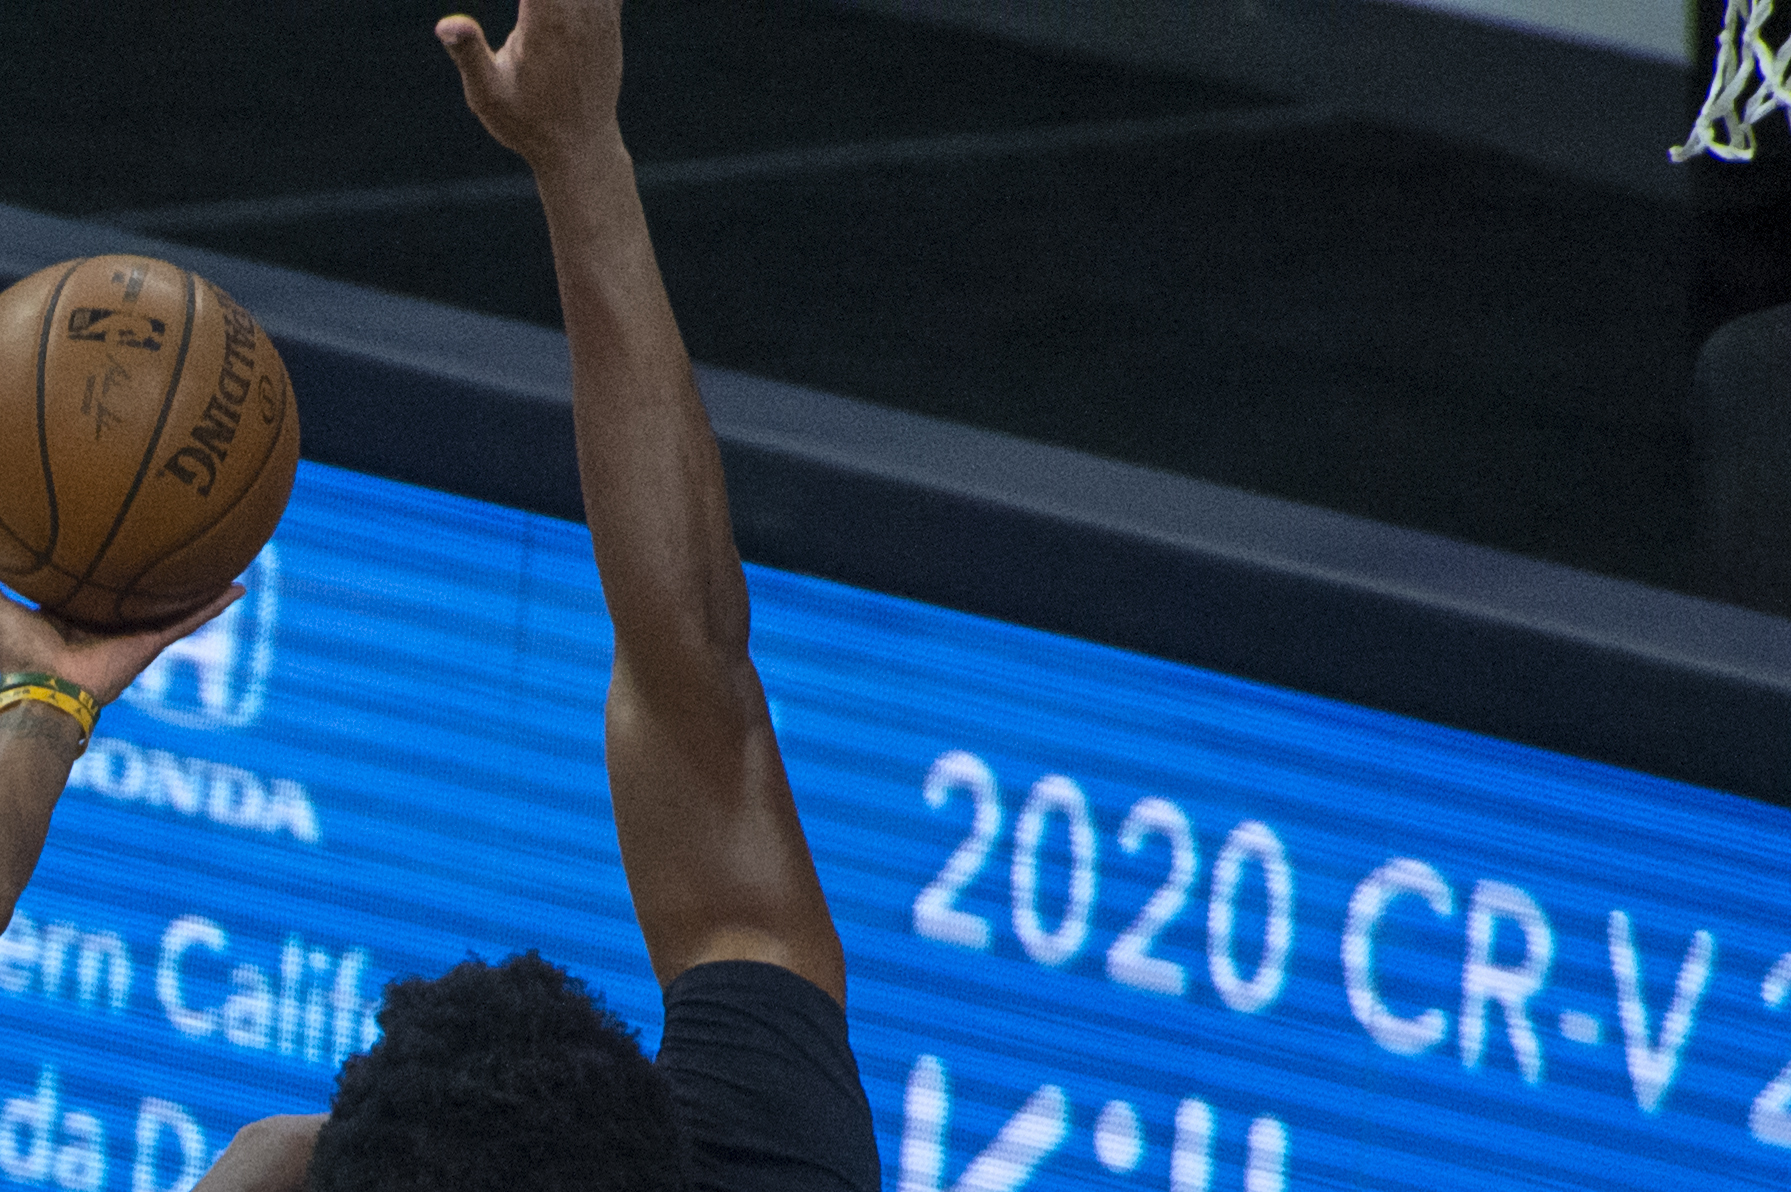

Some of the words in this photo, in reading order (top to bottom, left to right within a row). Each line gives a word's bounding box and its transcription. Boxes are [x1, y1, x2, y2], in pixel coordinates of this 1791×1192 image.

[70, 737, 322, 842] ONDA
[912, 750, 1295, 1014] 2020
[1341, 857, 1715, 1115] CR-V
